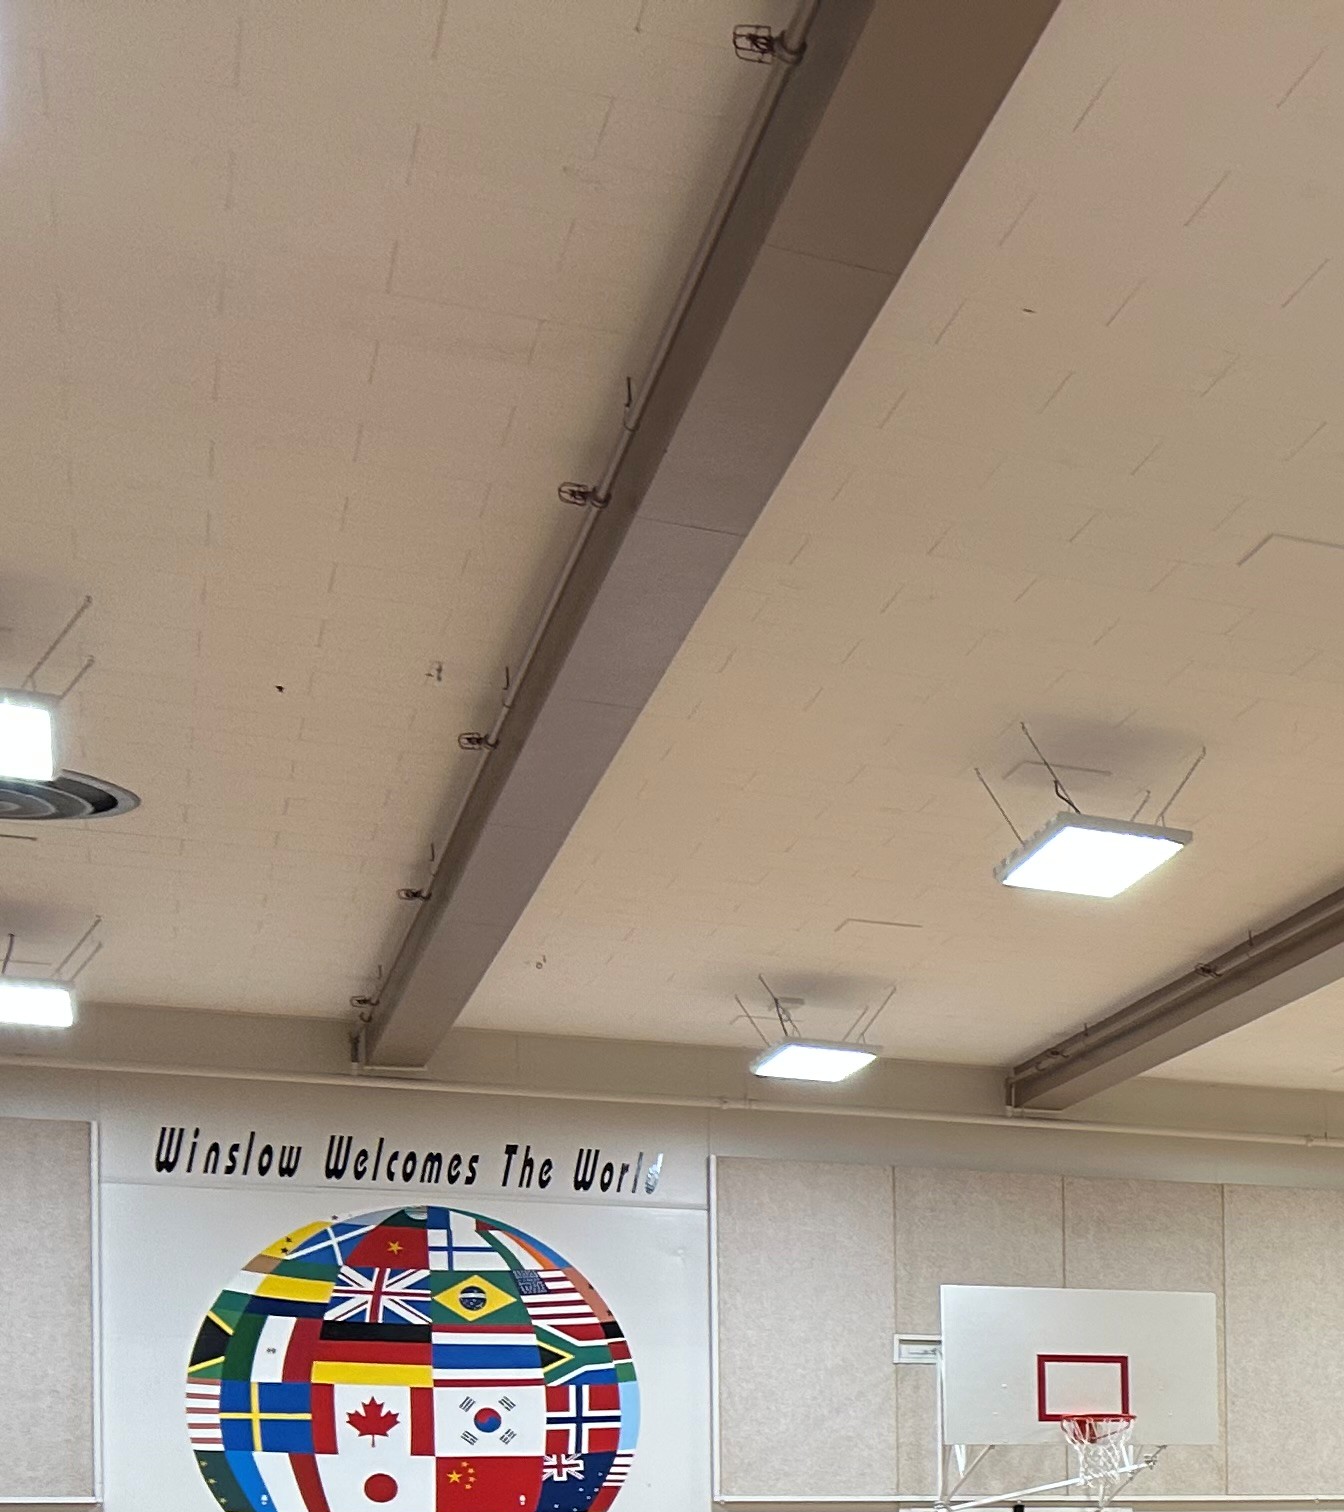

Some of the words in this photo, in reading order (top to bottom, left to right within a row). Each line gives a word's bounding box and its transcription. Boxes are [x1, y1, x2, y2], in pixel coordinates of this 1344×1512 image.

[155, 1126, 302, 1178] Winslow
[325, 1135, 479, 1185] Welcomes
[502, 1144, 553, 1189] The
[573, 1148, 664, 1194] World
